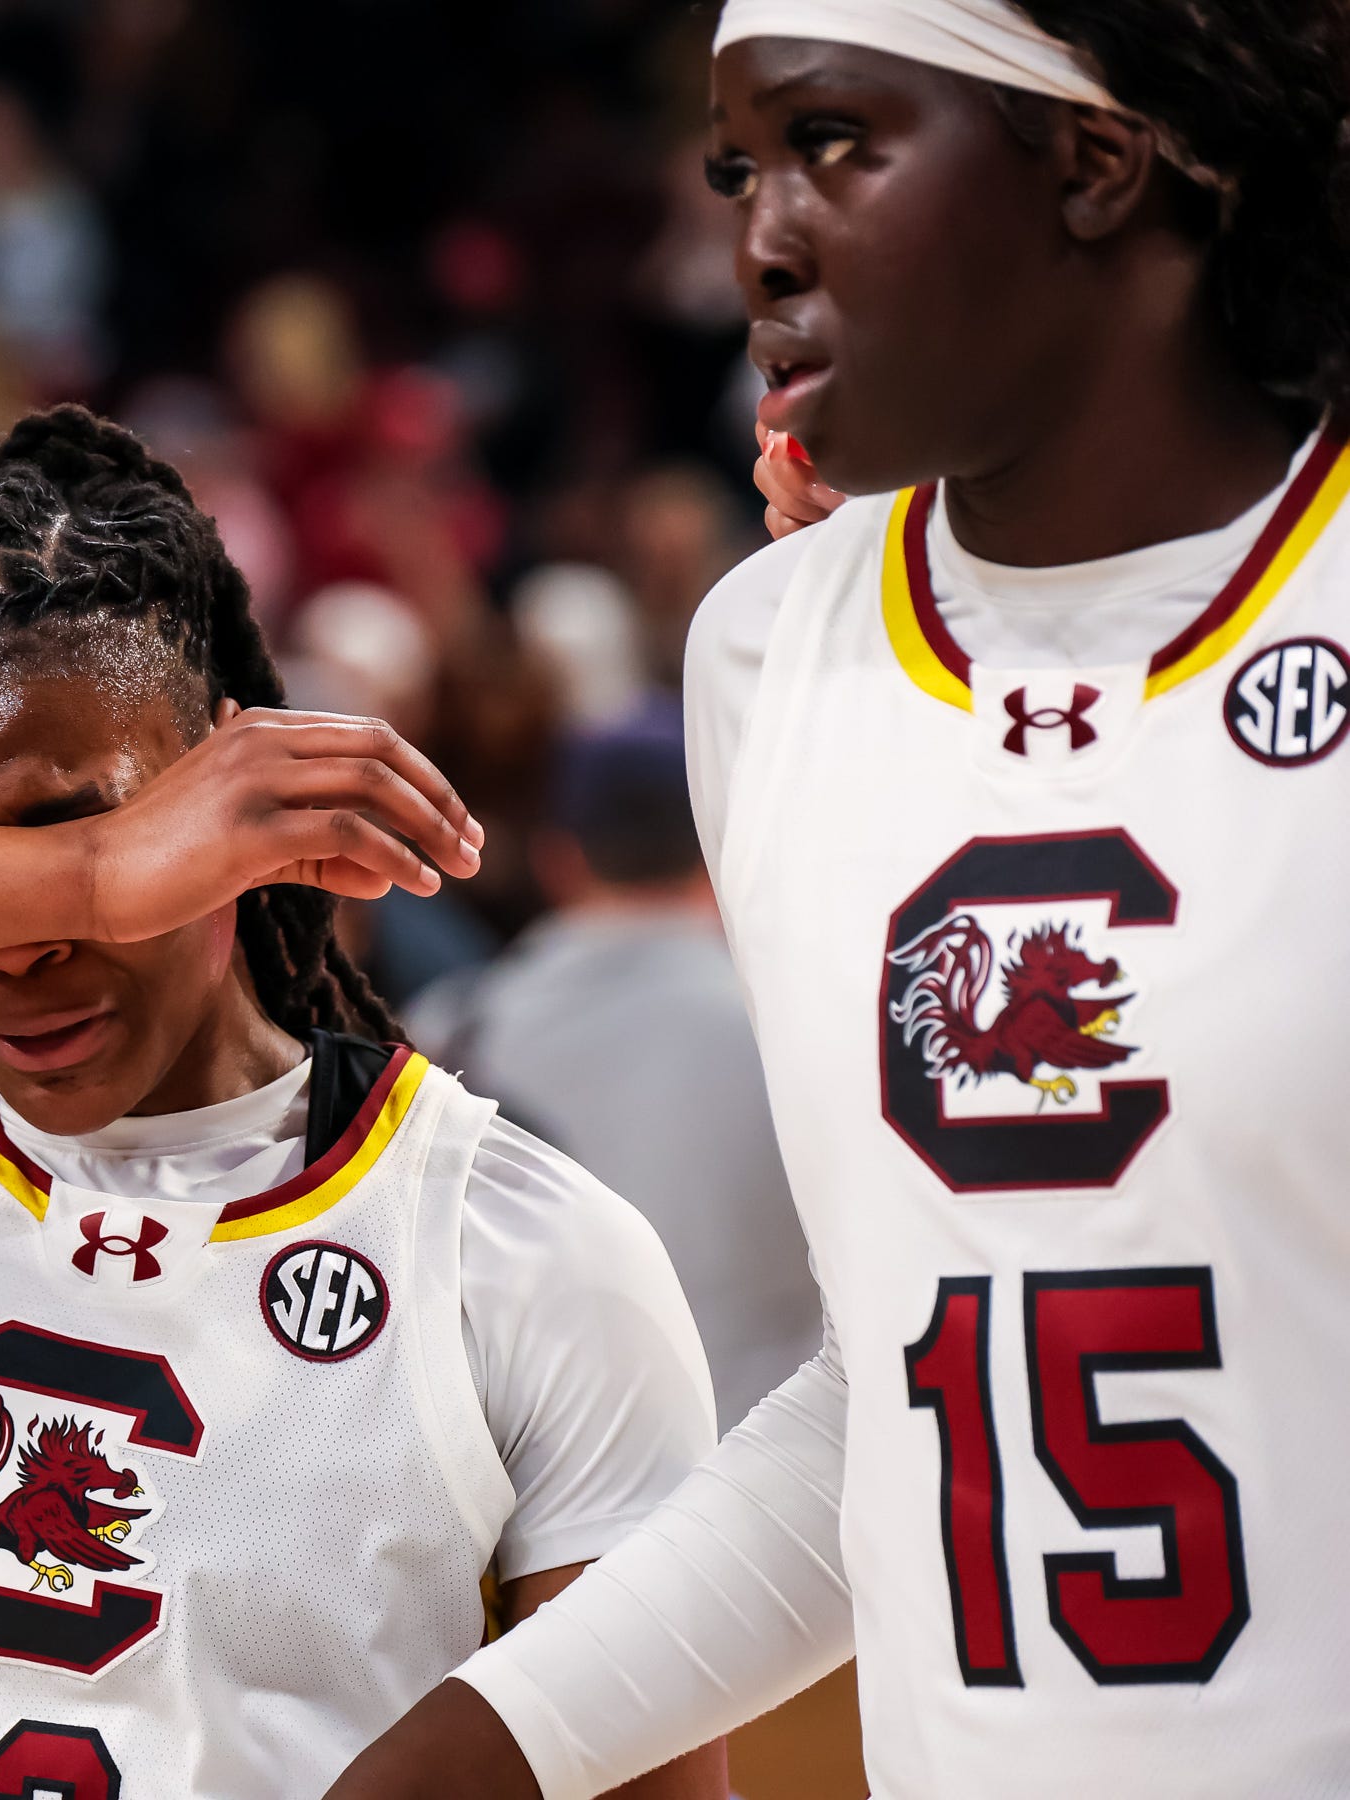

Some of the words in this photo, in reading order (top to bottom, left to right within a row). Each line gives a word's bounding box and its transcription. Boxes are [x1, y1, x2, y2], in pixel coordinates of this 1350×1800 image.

[1236, 645, 1349, 756] SEC
[878, 826, 1180, 1194] C
[270, 1249, 378, 1351] SEC
[903, 1265, 1251, 1689] 15
